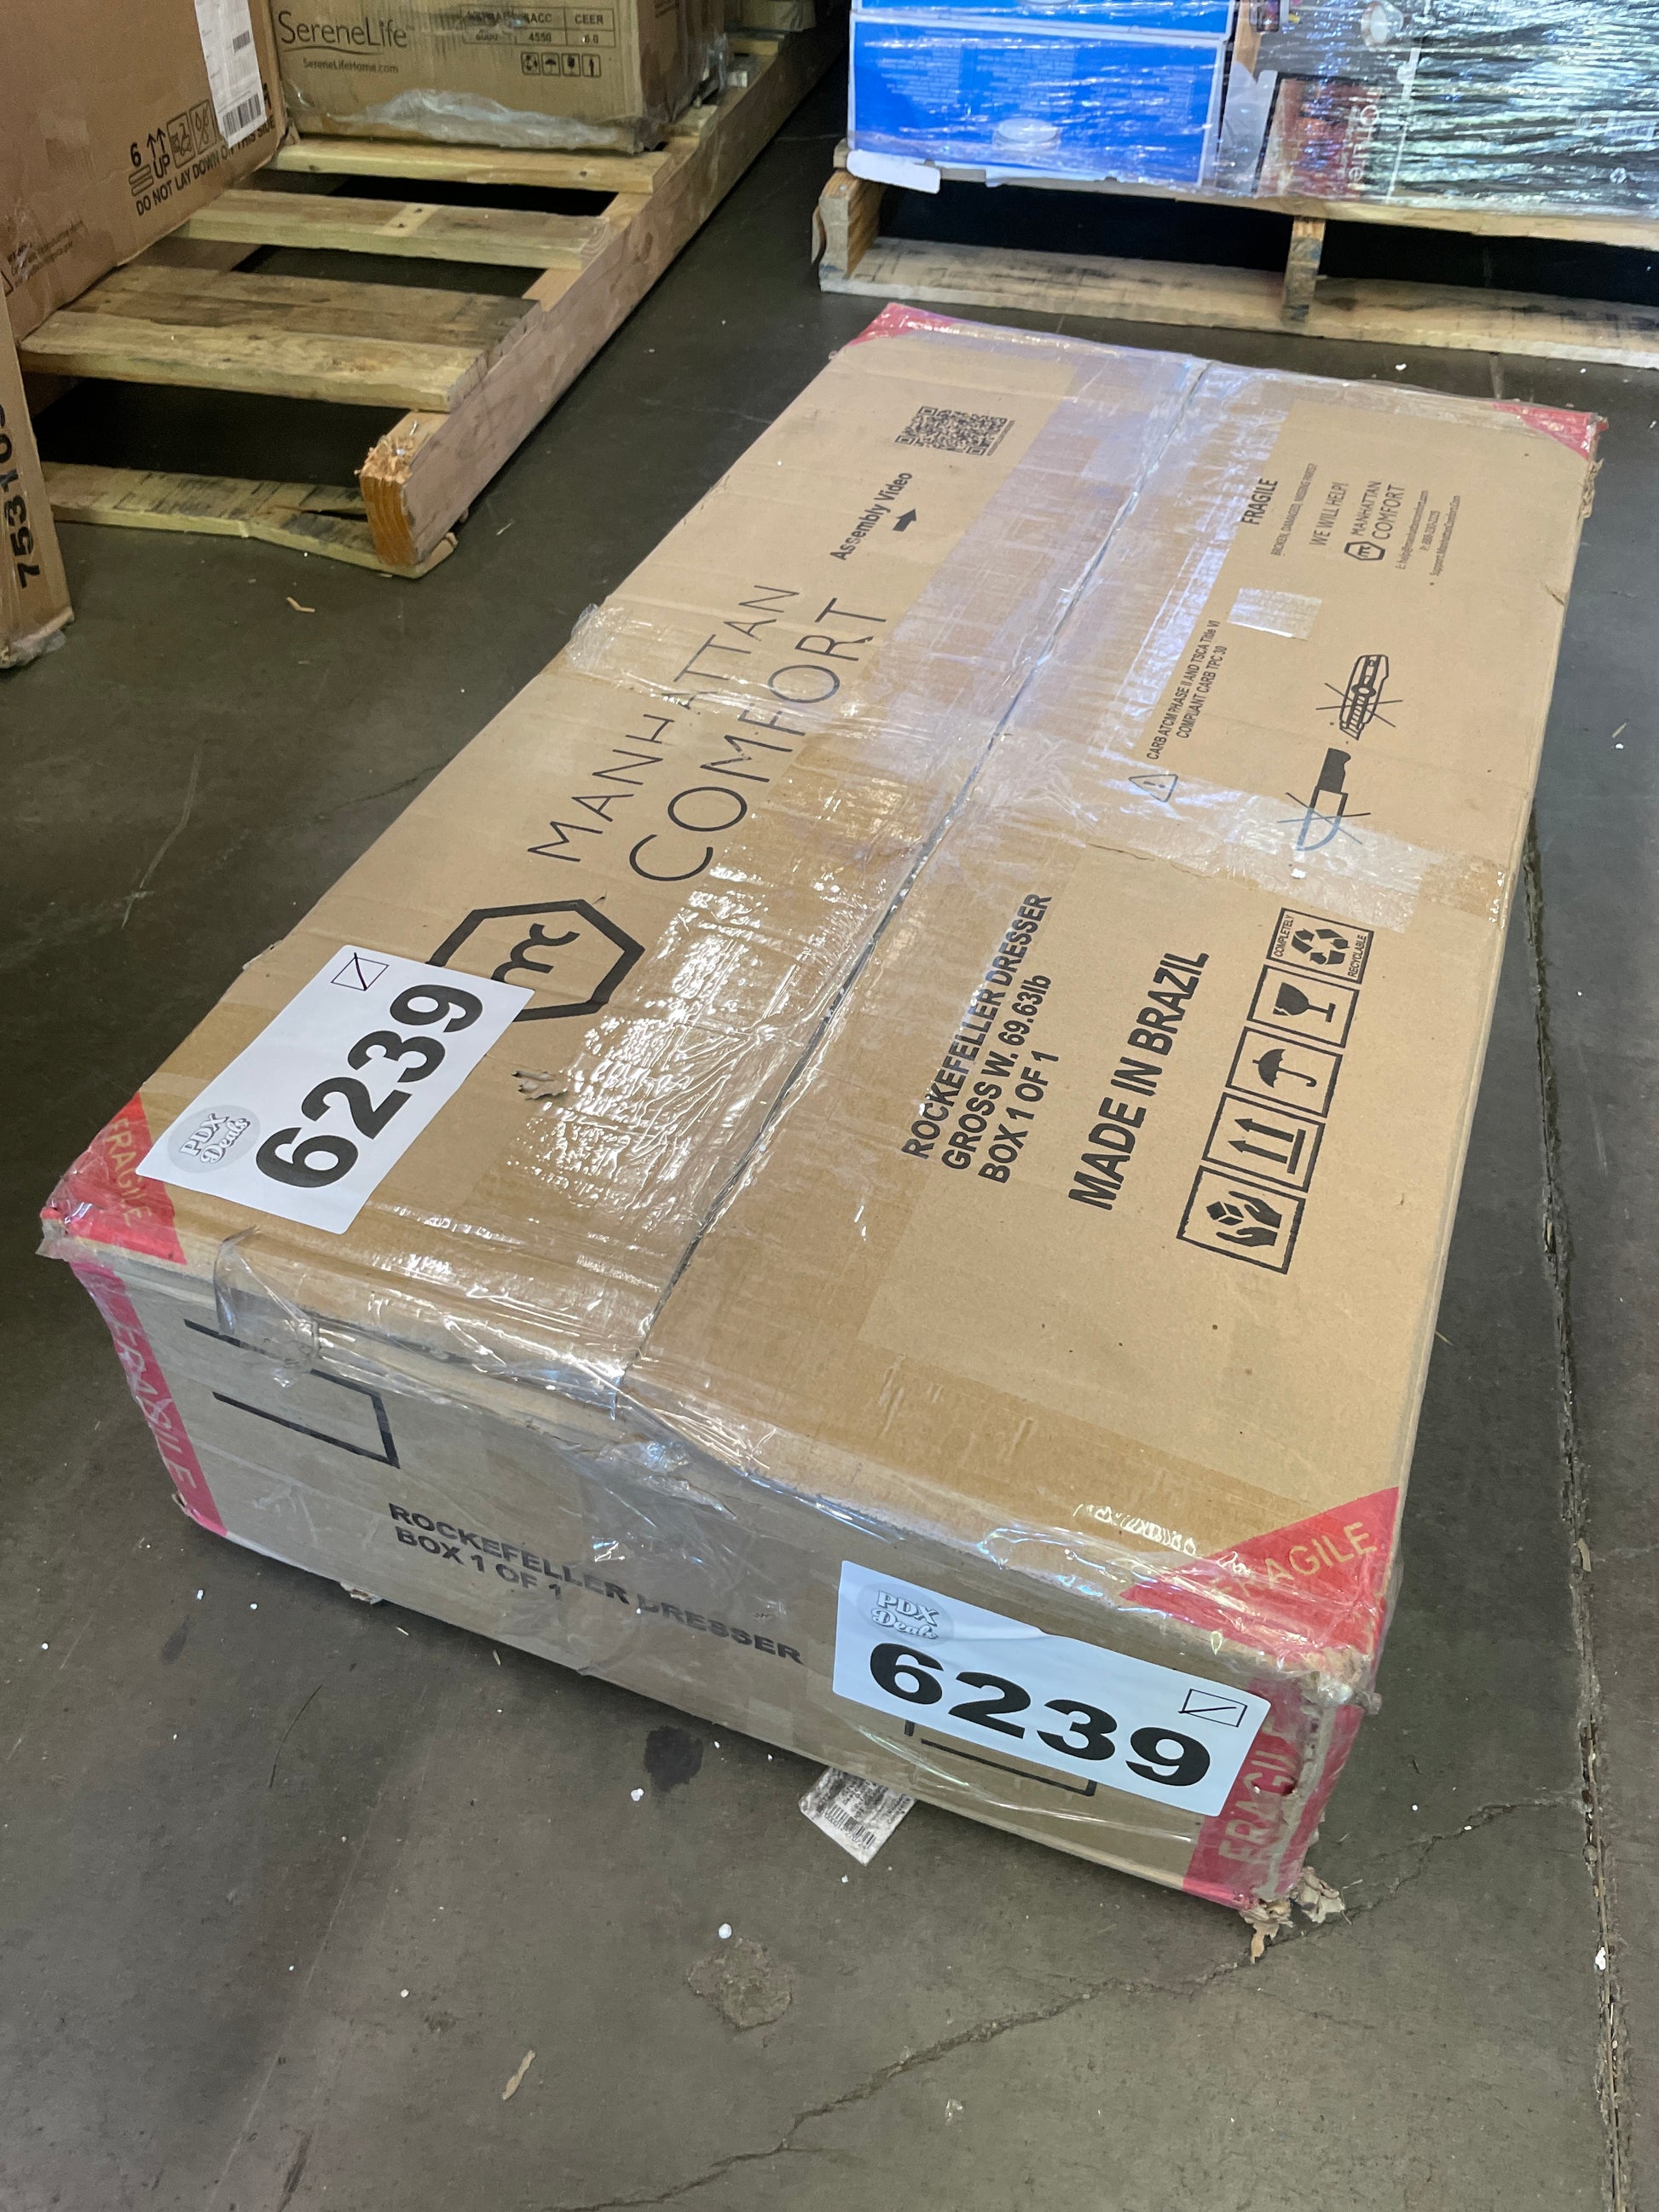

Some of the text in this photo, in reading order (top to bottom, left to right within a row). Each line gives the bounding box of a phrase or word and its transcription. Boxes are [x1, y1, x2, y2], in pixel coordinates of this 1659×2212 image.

[278, 10, 408, 49] SereneLife
[575, 14, 604, 25] CEER
[303, 57, 399, 74] SereneLifeHome.com
[130, 141, 142, 167] 6
[153, 153, 171, 179] UP
[136, 195, 152, 217] DO
[152, 180, 172, 206] NOT
[175, 170, 192, 191] LAY
[193, 153, 220, 180] DOWN
[0, 403, 40, 589] 75310
[830, 471, 913, 561] Assembly Video
[1240, 478, 1278, 525] FRAGILE
[1309, 482, 1349, 546] WE WILL HELP!
[1350, 480, 1382, 537] MANHATTAN
[1372, 483, 1405, 540] COMFORT
[1147, 620, 1220, 760] CARB ATCM PHASE II AND TSCA Title VI
[1197, 671, 1216, 693] CARB
[1206, 655, 1223, 672] TPC
[527, 585, 800, 862] MANHATTAN
[629, 597, 887, 882] COMFORT
[1176, 693, 1206, 739] COMPLIANT
[1274, 914, 1294, 957] COMPLETELY
[1347, 934, 1367, 978] RECYCLABLE
[901, 893, 1052, 1159] ROCKEFELLER DRESSER
[256, 984, 483, 1188] 6239
[941, 974, 1052, 1170] GROSS W. 69.63lb
[1068, 952, 1210, 1210] MADE IN BRAZIL
[179, 1113, 229, 1157] PDX
[200, 1118, 251, 1164] Deals
[978, 1049, 1059, 1183] BOX 1 OF 1
[388, 1503, 630, 1604] ROCKEFELLER
[395, 1526, 564, 1602] BOX 1 OF 1
[871, 1608, 939, 1639] Deals
[876, 1590, 939, 1627] PDX
[870, 1643, 1211, 1788] 6239
